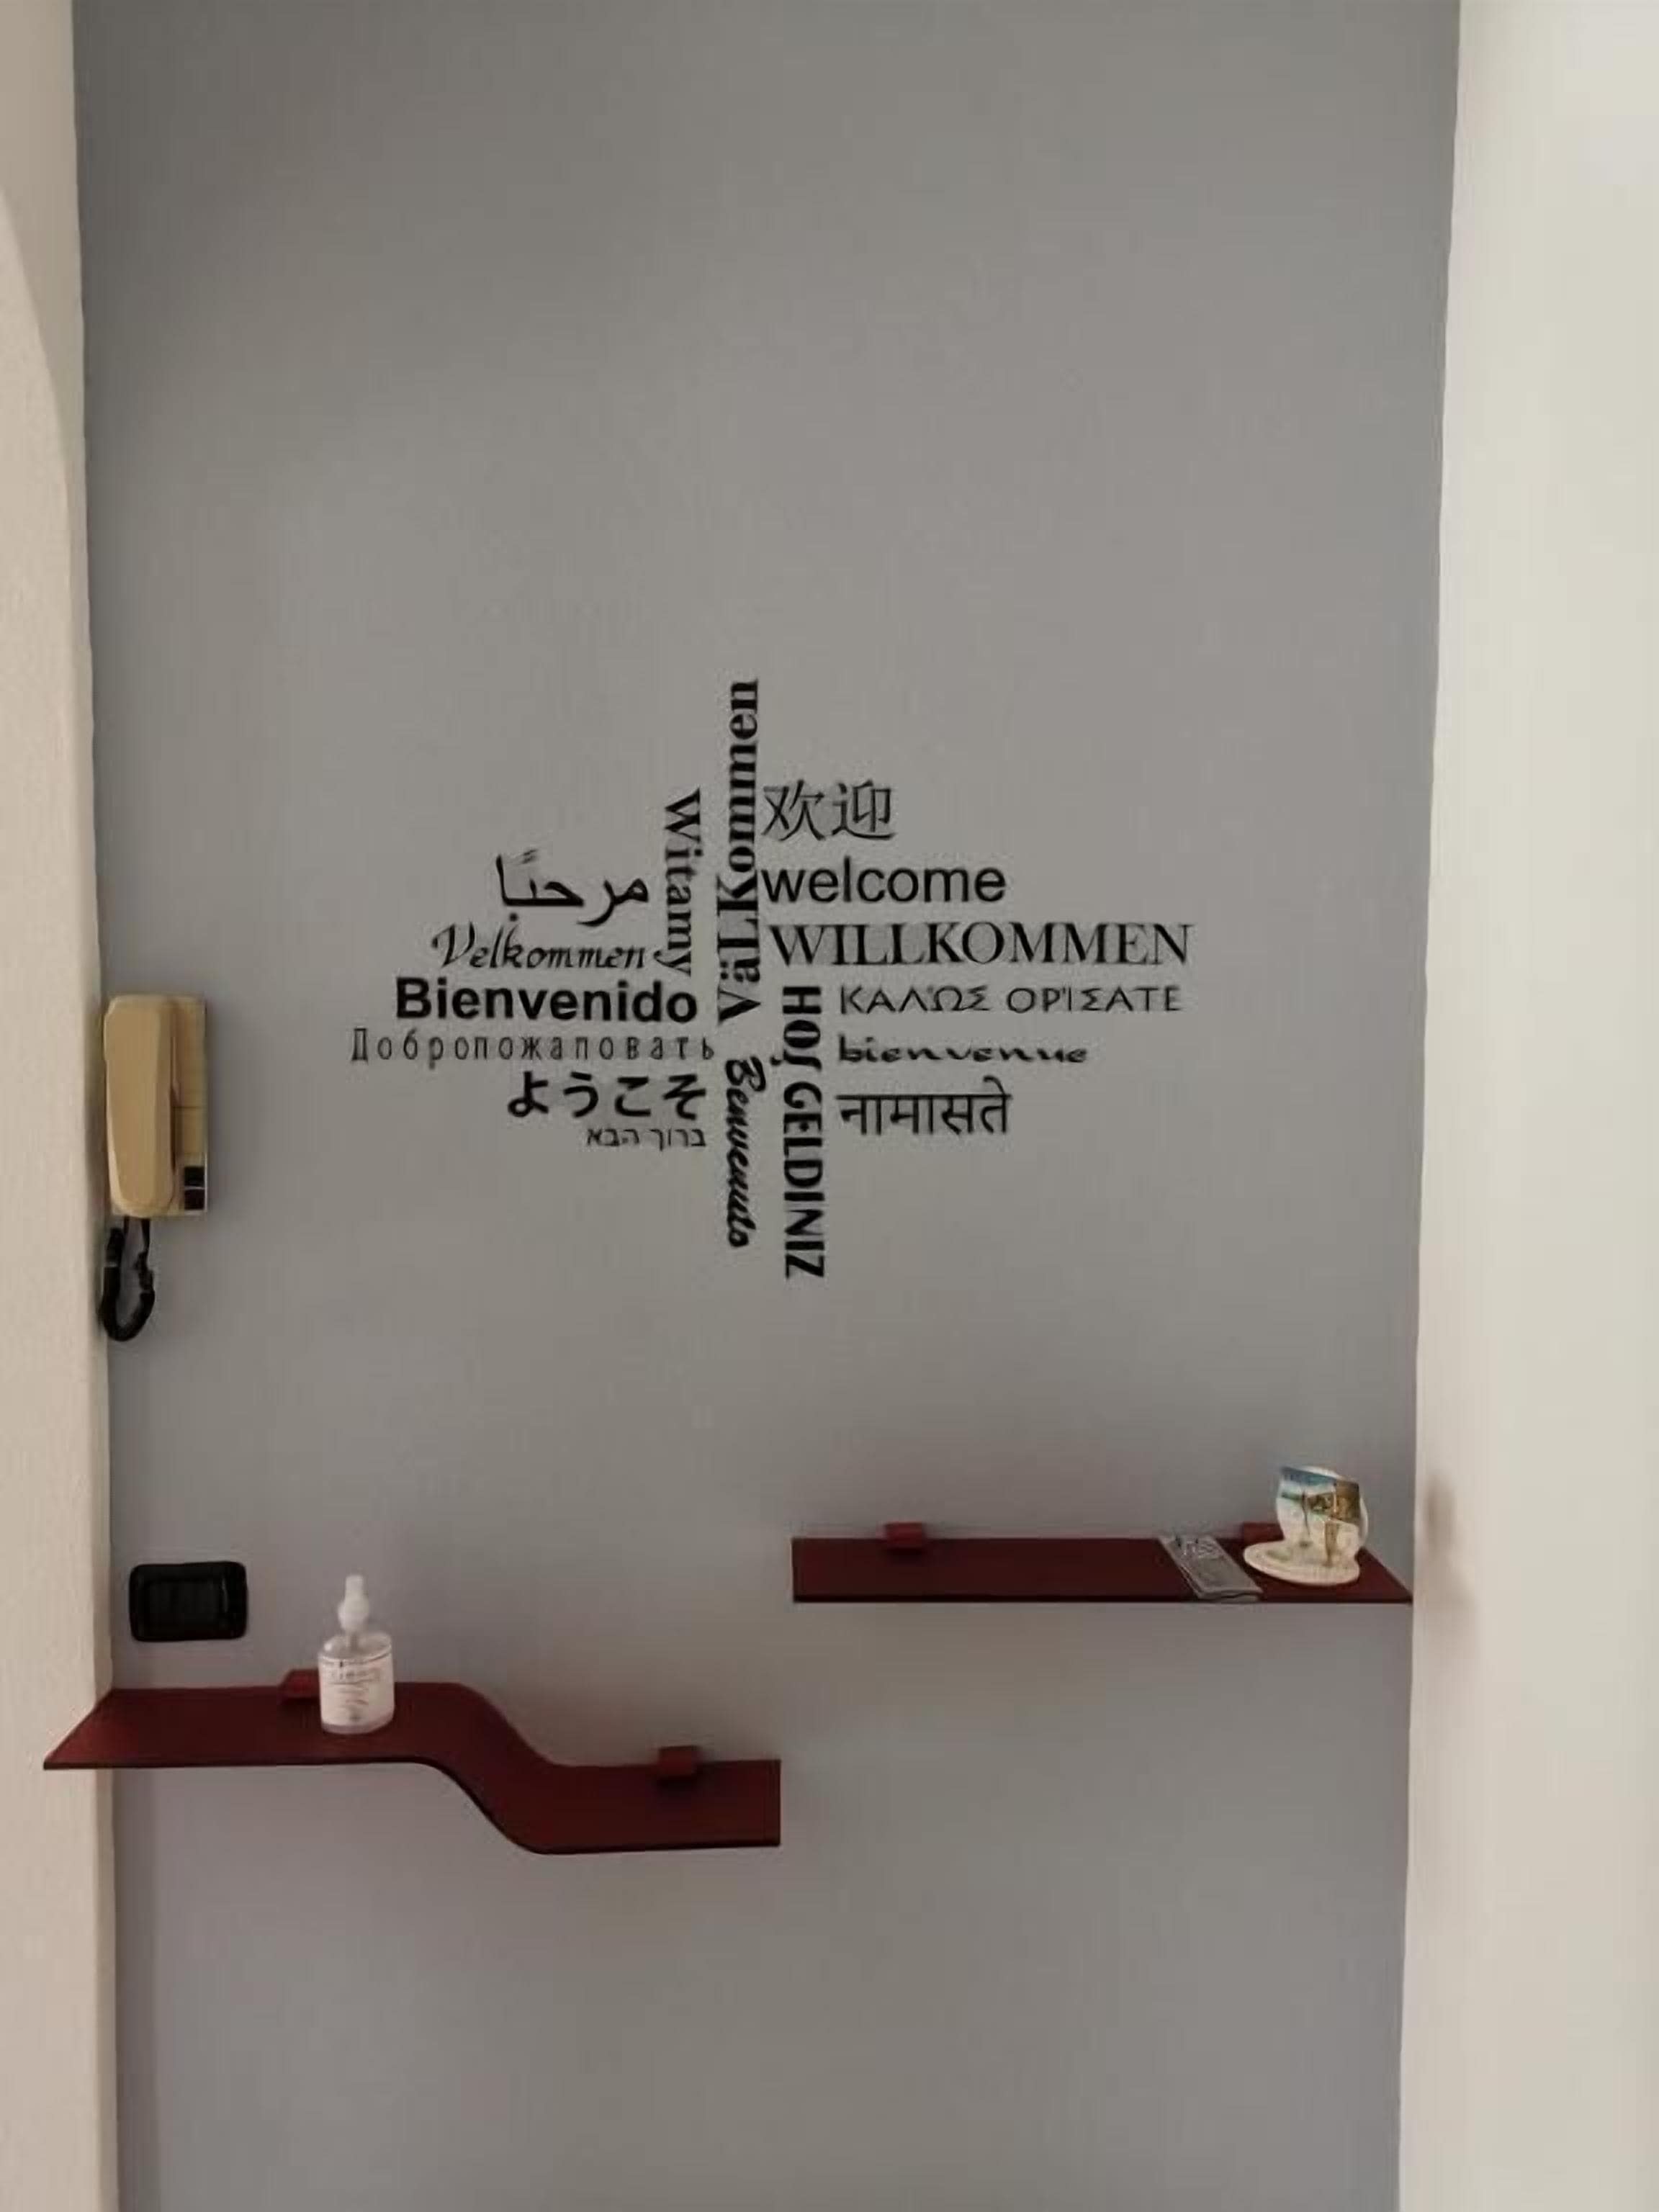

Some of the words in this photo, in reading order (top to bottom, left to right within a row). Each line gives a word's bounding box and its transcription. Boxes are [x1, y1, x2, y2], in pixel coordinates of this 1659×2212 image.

[760, 779, 896, 842] 欢迎
[652, 787, 703, 978] Witamy
[760, 855, 1007, 904] welcome
[431, 920, 647, 970] Velkommen
[767, 921, 1194, 967] WILLKOMMEN
[395, 976, 698, 1024] Bienvenido
[837, 1033, 1089, 1064] bienvenue
[506, 1070, 708, 1122] ようこそ
[835, 1074, 1015, 1136] नामासते
[585, 1126, 642, 1148] הבא
[647, 1126, 708, 1152] ברוך
[724, 1055, 768, 1249] Benvenuto
